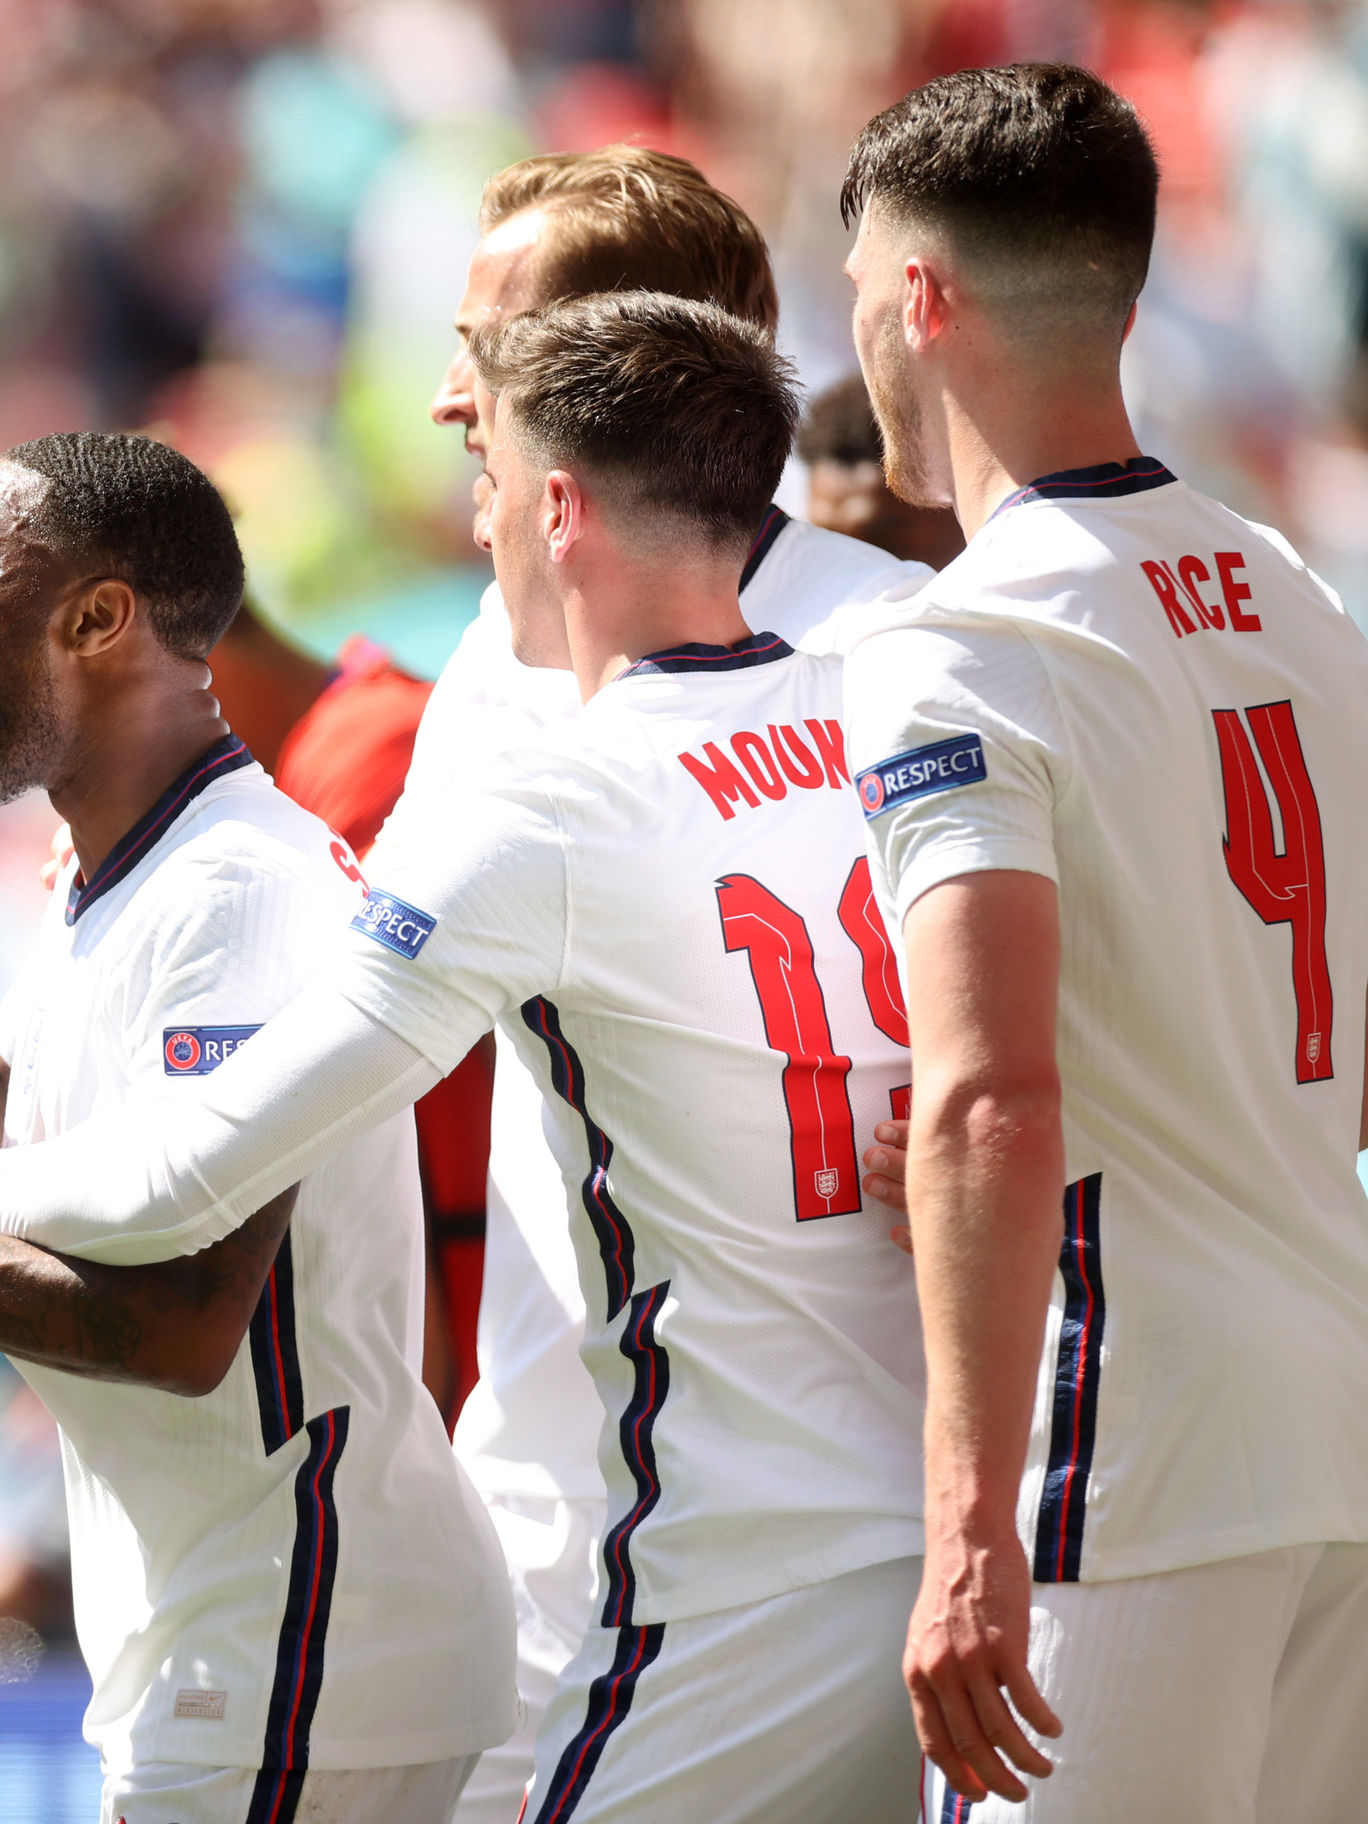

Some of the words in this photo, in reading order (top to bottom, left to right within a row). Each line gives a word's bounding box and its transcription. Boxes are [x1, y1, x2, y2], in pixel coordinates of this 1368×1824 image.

[1140, 552, 1262, 638] RICE
[883, 747, 981, 795] RESPECT
[359, 900, 429, 947] ESPECT
[1211, 699, 1334, 1084] 4
